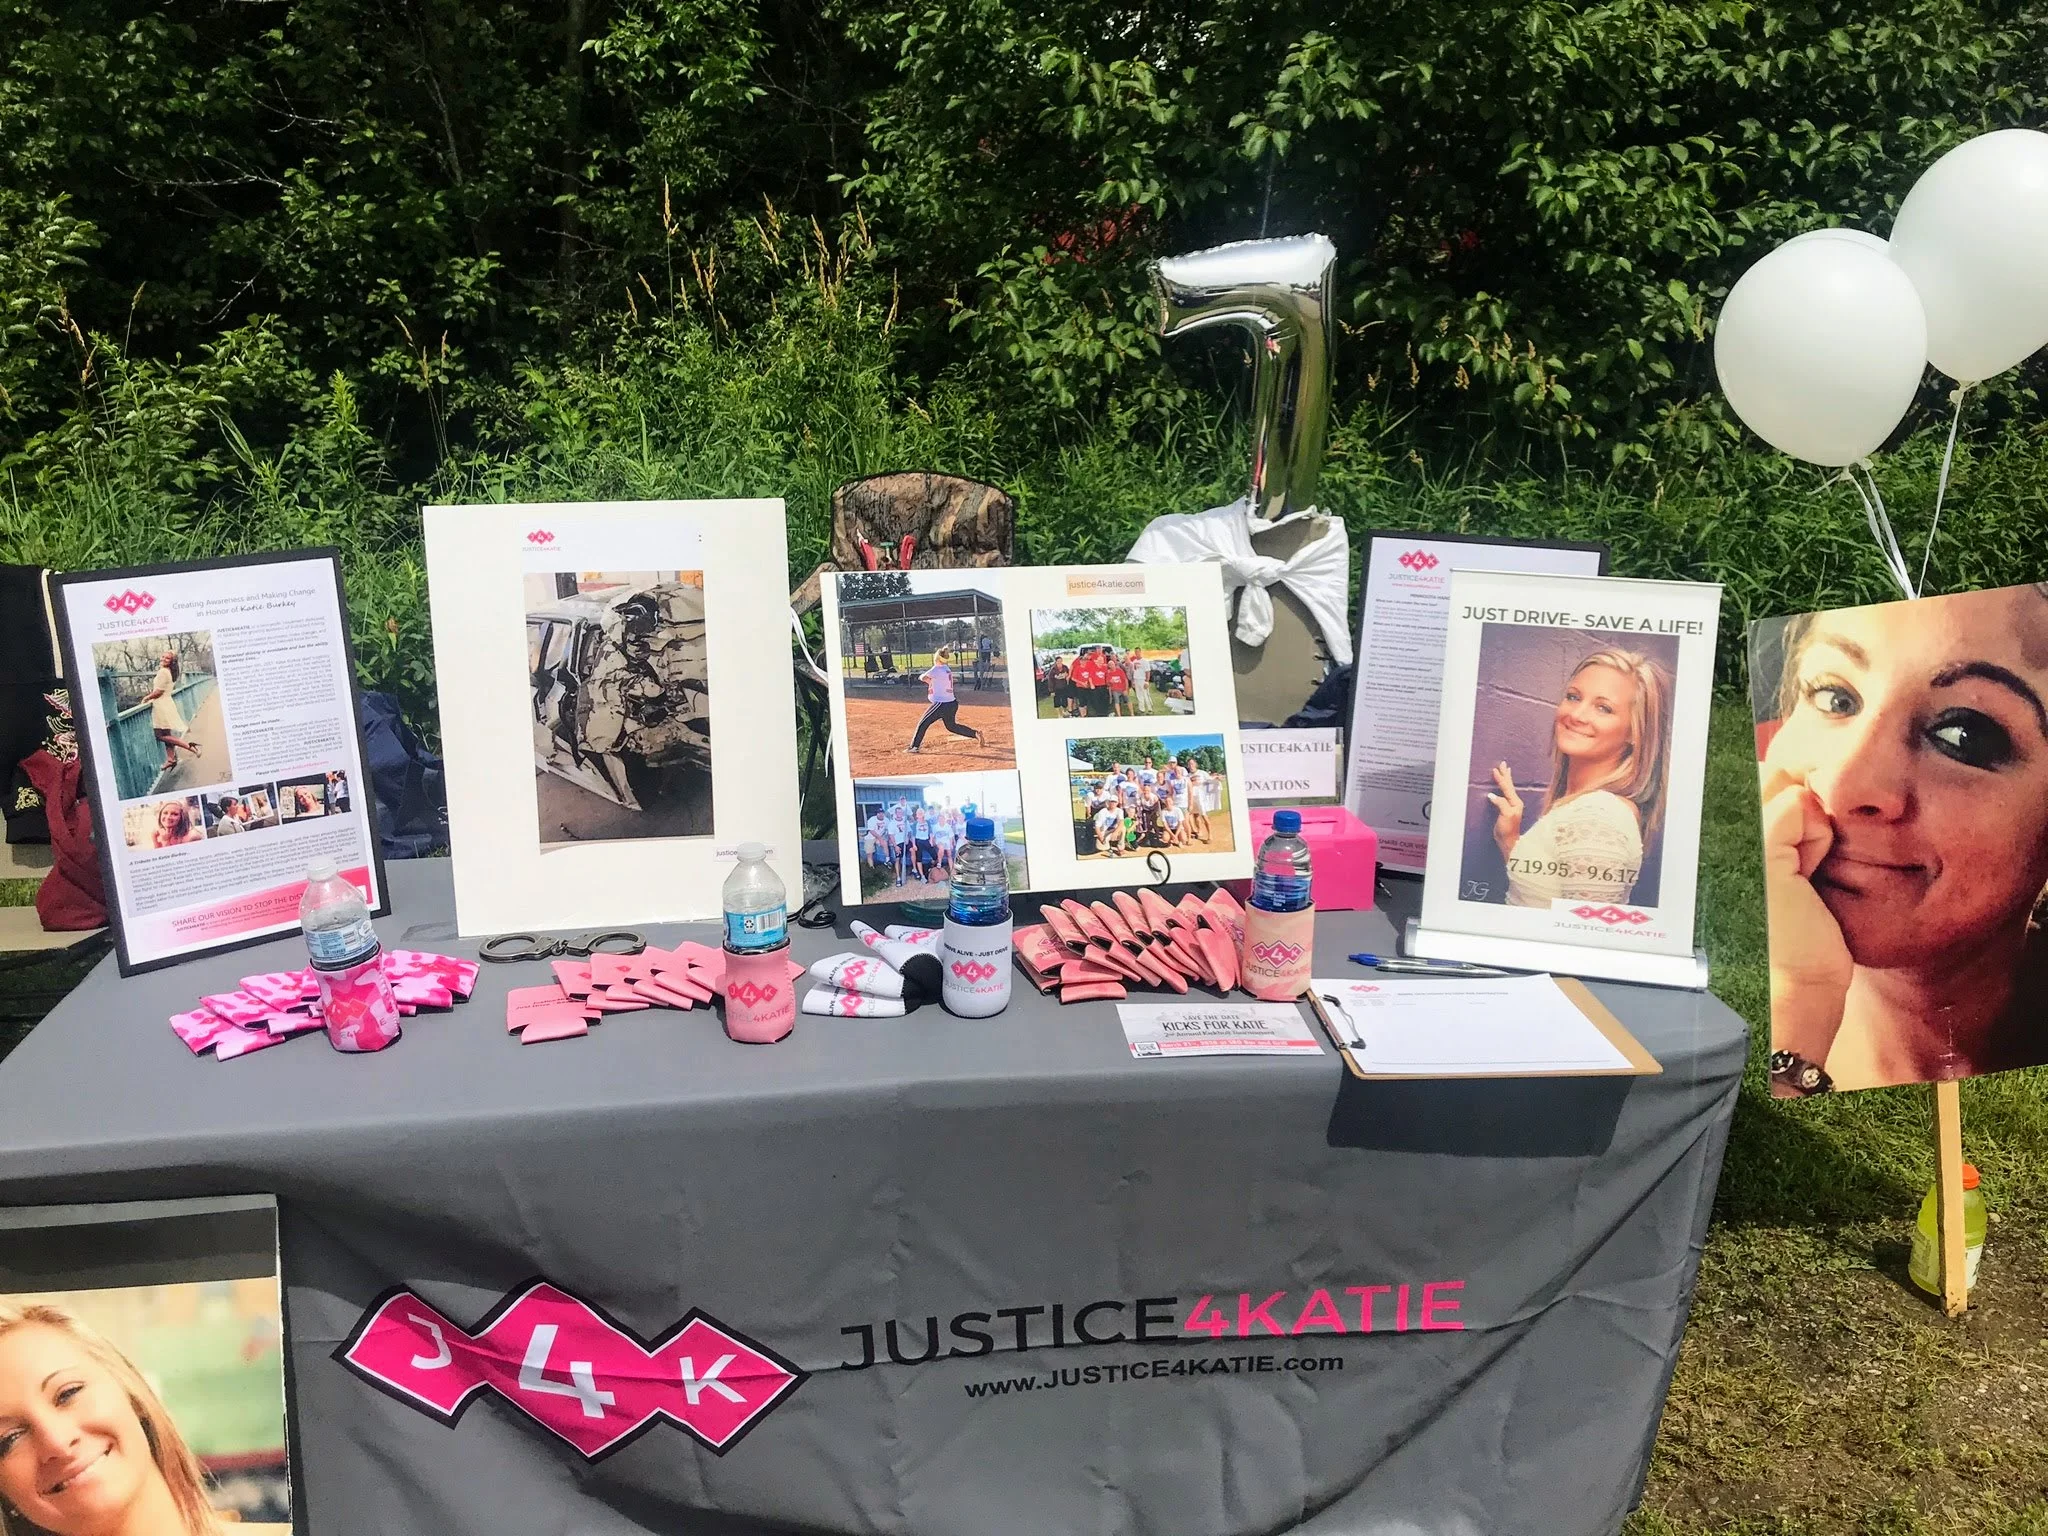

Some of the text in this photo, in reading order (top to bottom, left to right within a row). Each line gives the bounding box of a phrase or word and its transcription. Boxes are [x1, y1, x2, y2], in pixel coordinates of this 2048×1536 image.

[1069, 579, 1144, 590] justice4katie.com
[1388, 573, 1445, 584] JUSTICE4KATIE
[172, 587, 316, 610] Creating Awareness and Making Change
[205, 608, 229, 616] Honor
[230, 606, 239, 614] of
[97, 615, 170, 631] JUSTICE4KATIE
[1462, 606, 1508, 622] JUST
[1584, 614, 1634, 631] SAVE
[1639, 618, 1653, 632] A
[1658, 618, 1704, 636] LIFE!
[1240, 741, 1334, 754] USTICE4KATIE
[1245, 779, 1310, 792] ONATIONS
[1399, 841, 1414, 849] OUR
[1509, 858, 1569, 878] 7.19.95
[1588, 865, 1637, 884] 9.6.17
[171, 915, 197, 928] SHARE
[198, 912, 216, 923] OUR
[216, 906, 242, 918] VISION
[243, 903, 254, 912] TO
[254, 899, 273, 910] STOP
[274, 896, 288, 905] THE
[289, 892, 303, 902] DIST
[1553, 920, 1668, 939] JUSTICE4KATIE
[956, 949, 974, 957] ALIVE
[944, 979, 1005, 994] JUSTICE4KATIE
[1162, 1020, 1269, 1031] KICKS FOR KATIE
[839, 1279, 1467, 1371] JUSTICE4KATIE
[407, 1313, 748, 1419] J4K
[964, 1354, 1345, 1399] www.JUSTICE4KATIE.com
